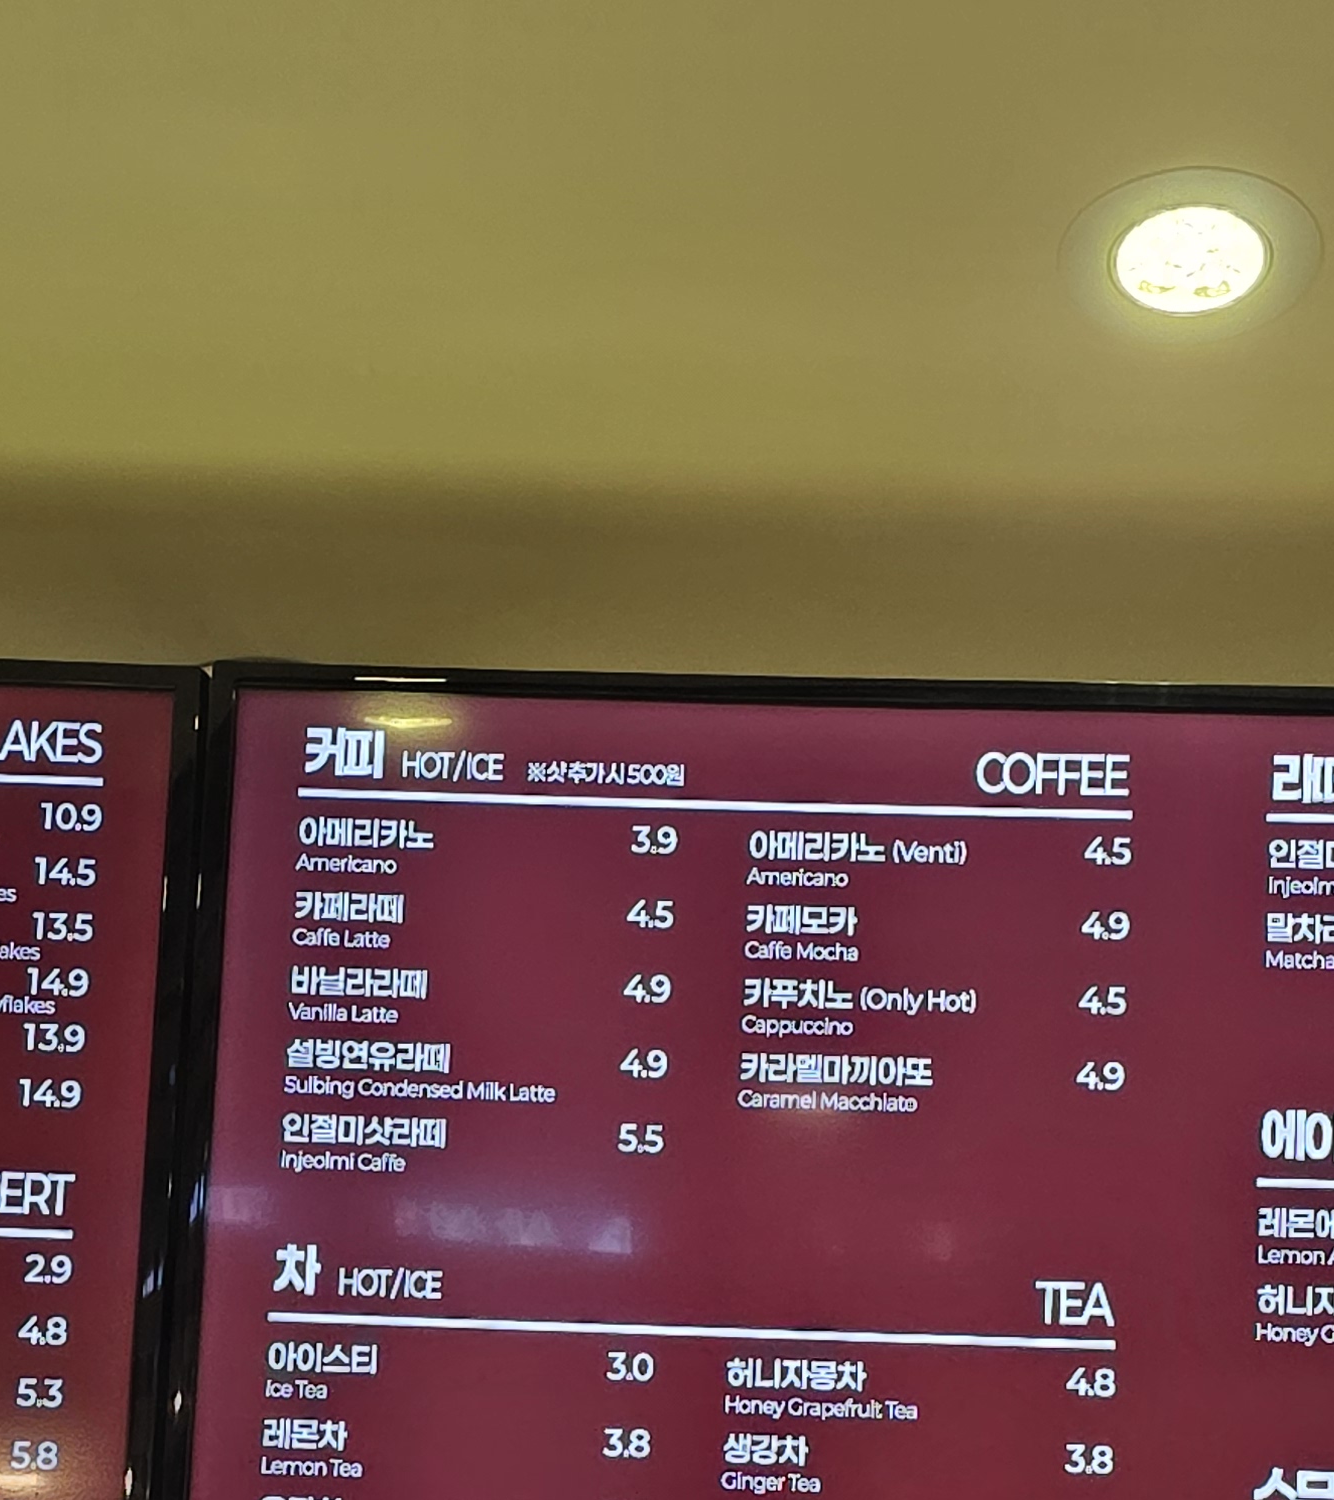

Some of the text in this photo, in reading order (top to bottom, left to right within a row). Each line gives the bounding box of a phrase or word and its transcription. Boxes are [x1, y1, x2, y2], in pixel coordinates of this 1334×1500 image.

[304, 726, 504, 782] 커피 HOT/ICE
[975, 751, 1130, 797] COFFEE
[40, 802, 102, 831] 10.9
[298, 815, 434, 849] 아메리카노
[630, 825, 678, 855] 3.9
[749, 829, 967, 865] 아메리카노 (Venti)
[1083, 835, 1132, 865] 4.5
[34, 856, 96, 887] 14.5
[294, 852, 397, 874] Americano
[745, 866, 849, 887] Americano
[294, 891, 404, 924] 카페라떼
[626, 898, 674, 929] 4.5
[745, 903, 858, 937] 카페모카
[31, 911, 93, 942] 13.5
[1080, 911, 1130, 940] 4.9
[744, 940, 859, 962] Caffe Mocha
[291, 964, 428, 1000] 바닐라라떼
[622, 973, 671, 1003] 4.9
[743, 976, 976, 1016] 카푸치노 (Only Hot)
[288, 1001, 399, 1024] Vanilla Latte
[1077, 985, 1127, 1016] 4.5
[741, 1014, 853, 1038] Cappuccino
[286, 1038, 451, 1074] 설빙연유라떼
[619, 1048, 668, 1078] 4.9
[739, 1052, 933, 1087] 카라멜마끼아또
[1075, 1061, 1125, 1091] 4.9
[736, 1089, 918, 1112] Caramel Macchiato
[282, 1112, 447, 1149] 인절미샷라떼
[617, 1122, 664, 1154] 5.5
[23, 1253, 72, 1284] 2.9
[1257, 1244, 1325, 1266] Lemon
[272, 1243, 443, 1300] 차 HOT/ICE
[1034, 1280, 1115, 1327] TEA
[17, 1314, 67, 1346] 4.8
[267, 1340, 378, 1375] 아이스티
[606, 1351, 654, 1382] 3.0
[726, 1356, 867, 1392] 허니자몽차
[1065, 1366, 1116, 1398] 4.8
[16, 1377, 63, 1408] 5.3
[262, 1417, 348, 1452] 레몬차
[722, 1432, 809, 1467] 생강차
[9, 1440, 59, 1471] 5.8
[260, 1455, 363, 1478] Lemon Tea
[1064, 1443, 1113, 1475] 3.8
[719, 1471, 821, 1495] Ginger Tea
